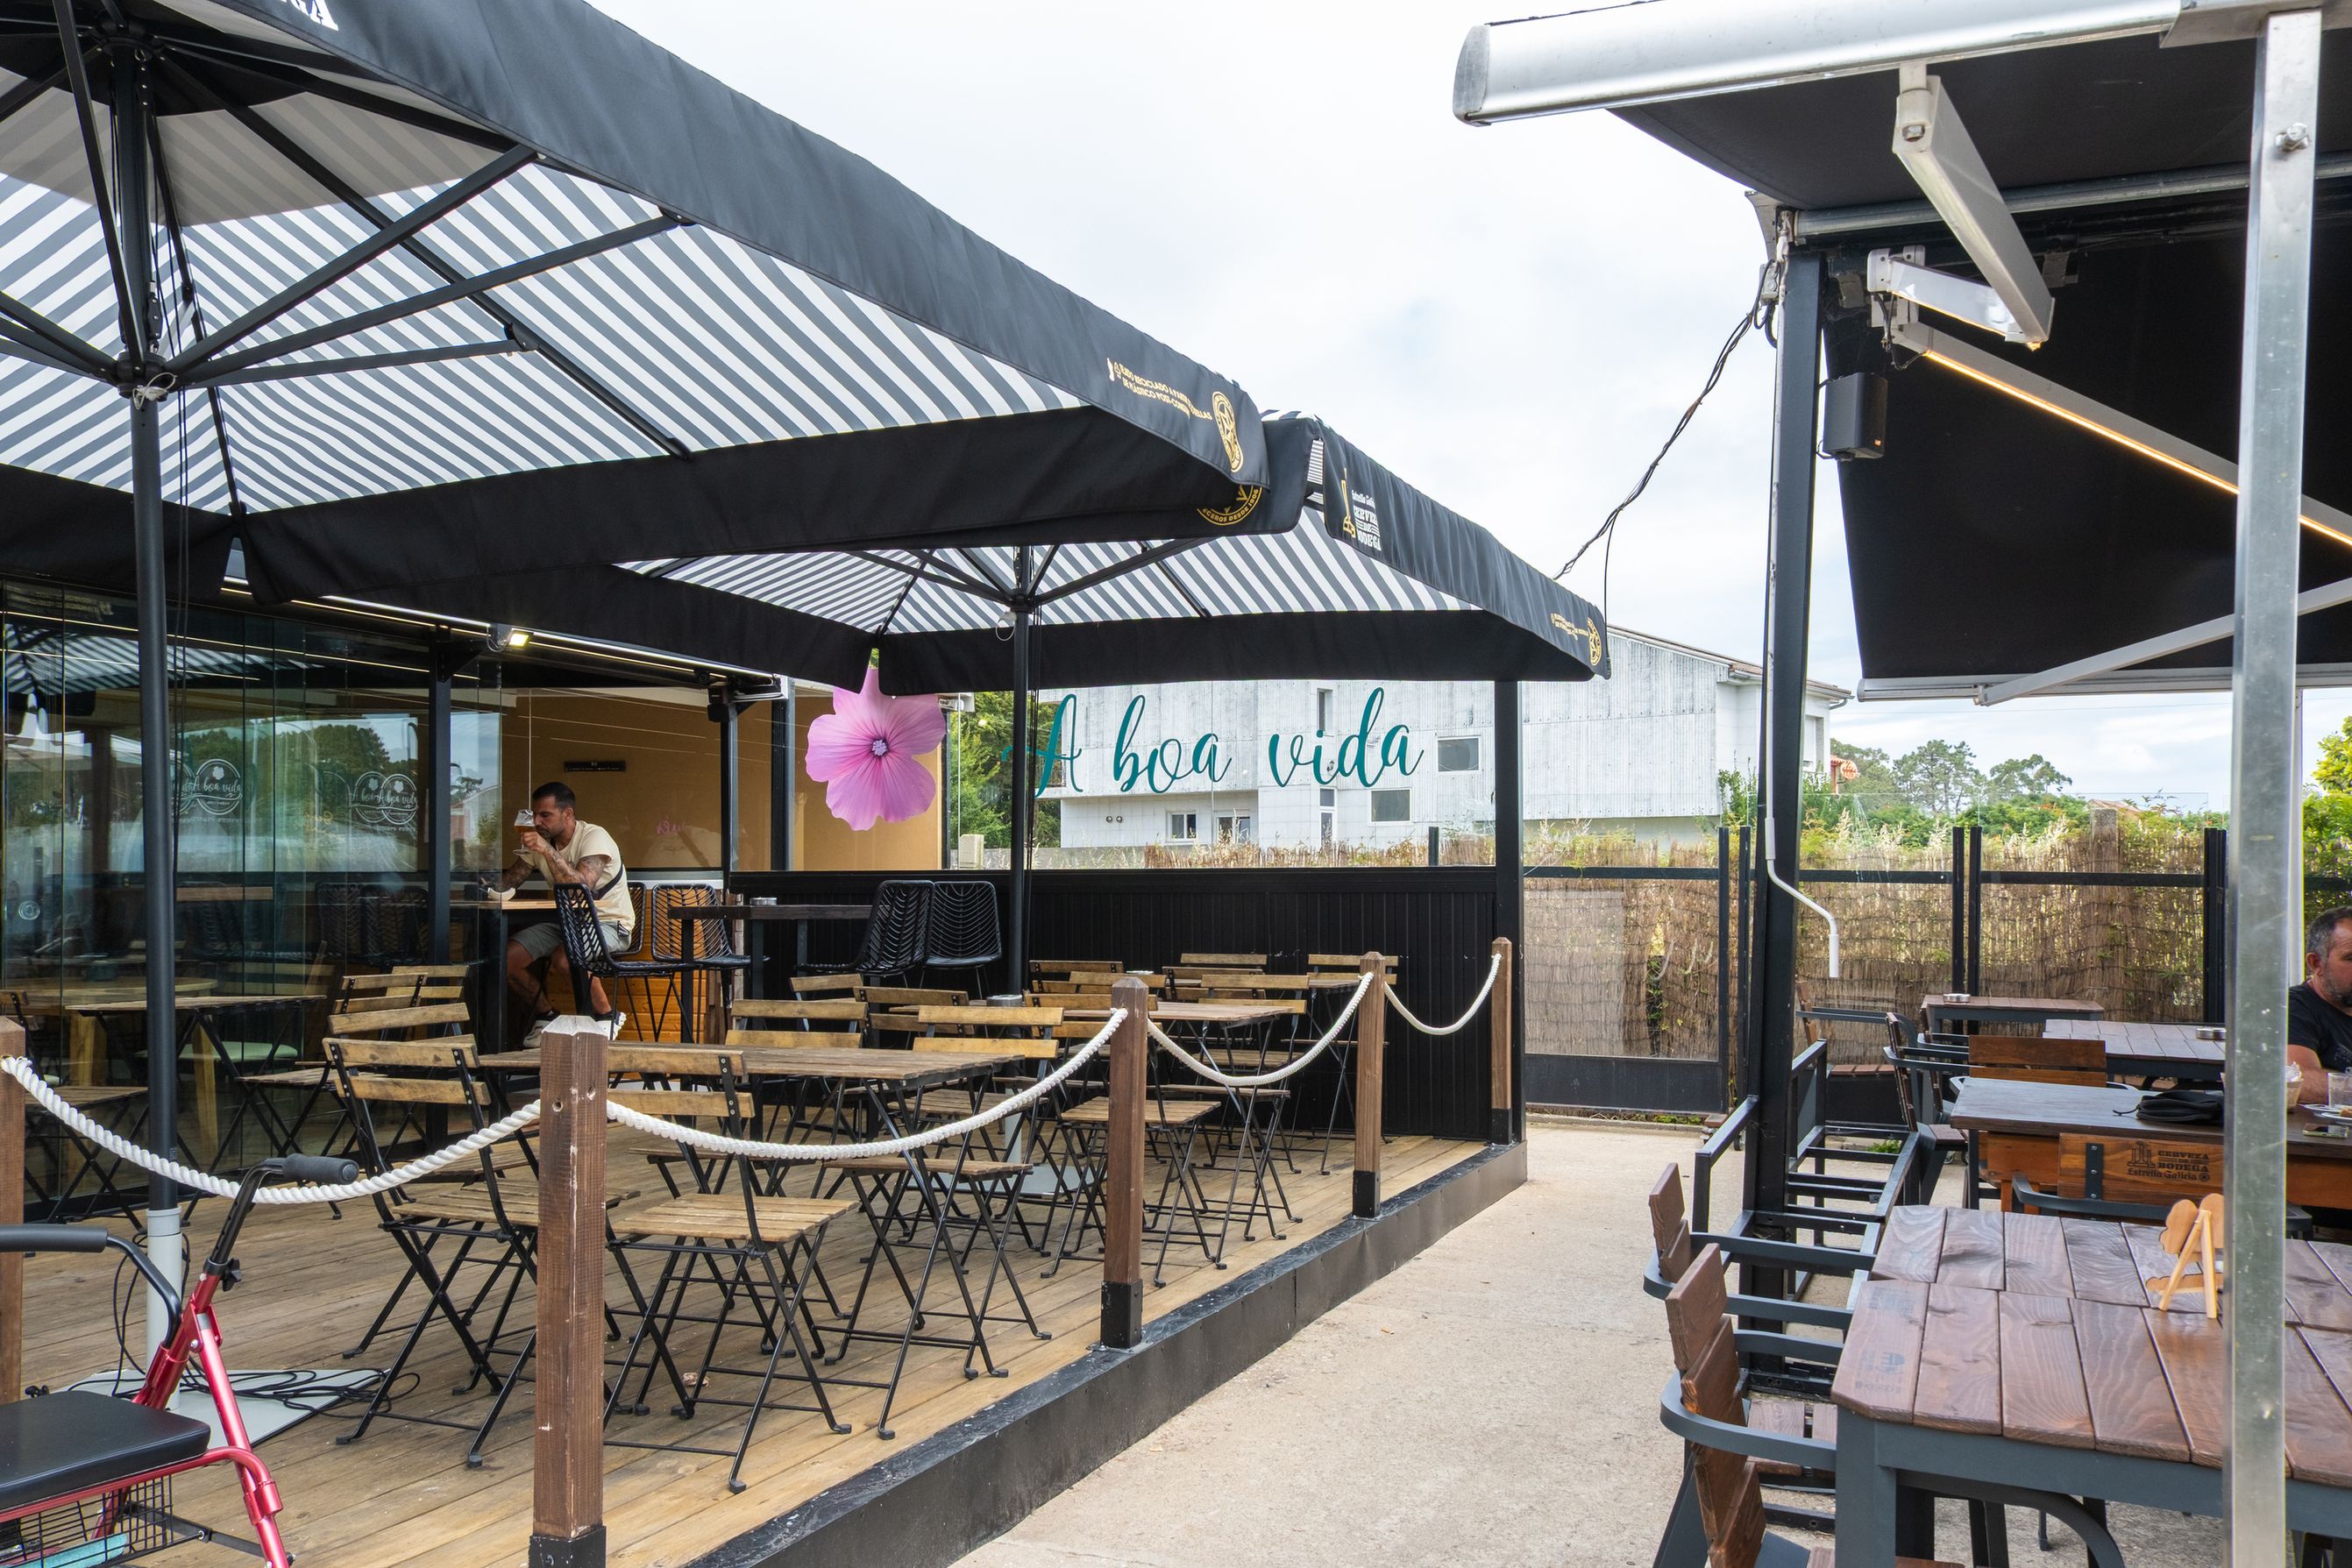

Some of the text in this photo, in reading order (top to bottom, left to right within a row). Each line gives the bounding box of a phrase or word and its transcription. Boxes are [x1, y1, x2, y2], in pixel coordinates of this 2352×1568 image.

[1228, 506, 1249, 521] DESDE
[1001, 686, 1425, 798] A boa vida
[2158, 1150, 2209, 1160] CERVEZA
[2128, 1167, 2198, 1181] Estrella Galicia
[2157, 1162, 2209, 1173] BODEGA
